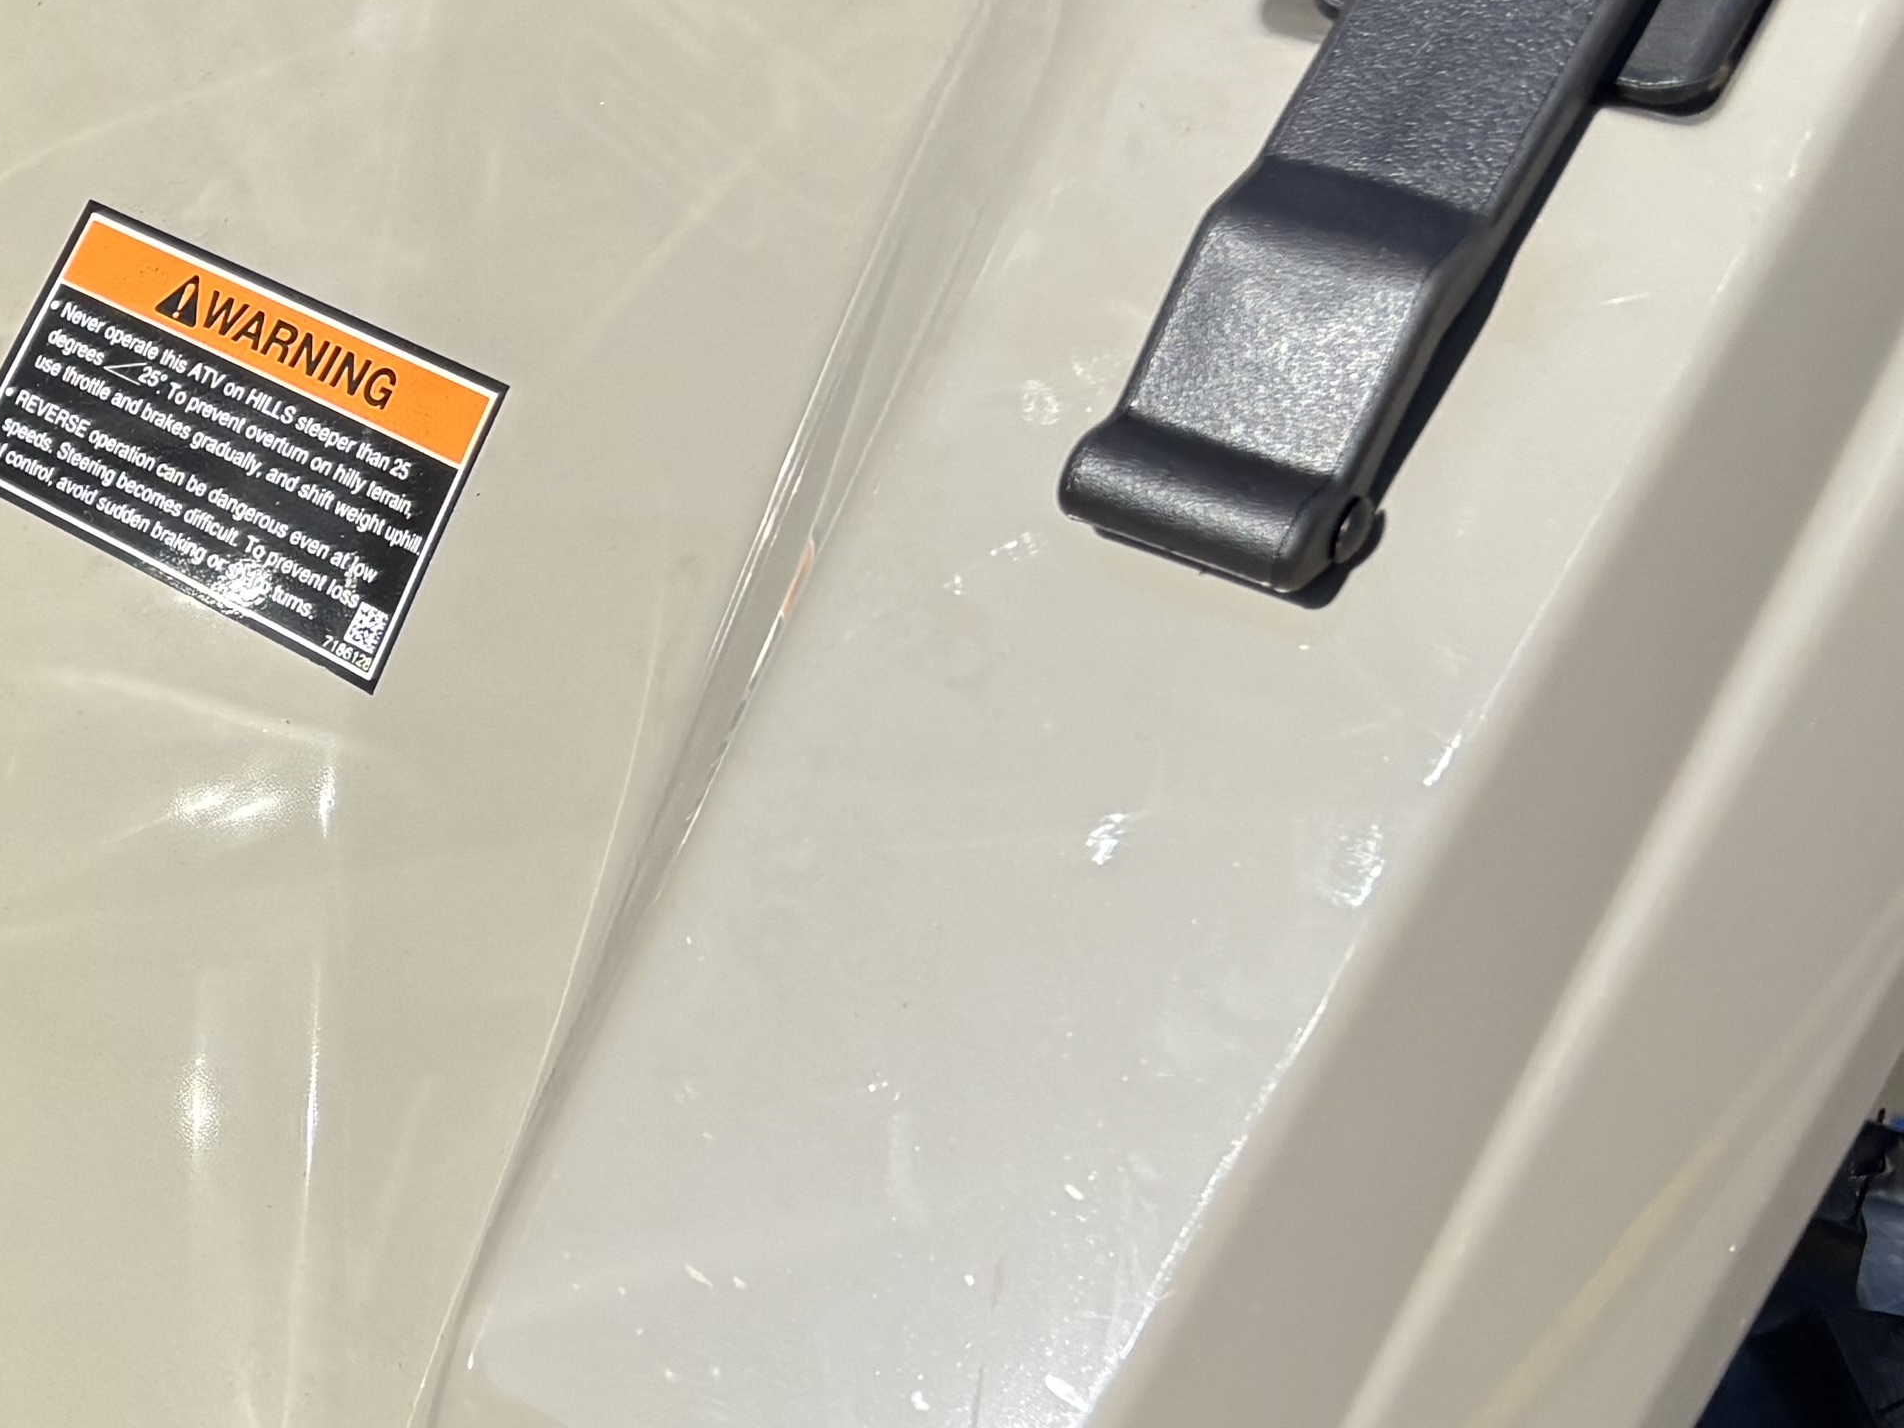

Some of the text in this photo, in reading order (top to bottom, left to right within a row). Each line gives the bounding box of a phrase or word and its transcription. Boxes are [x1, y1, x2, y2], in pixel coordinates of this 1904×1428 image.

[47, 328, 104, 365] degrees
[167, 381, 186, 404] To
[184, 396, 246, 433] prevent
[244, 424, 309, 464] overturn
[309, 456, 332, 475] on
[332, 463, 367, 493] hilly
[366, 480, 411, 519] terrain,
[60, 301, 411, 480] Never operate this ATV on HILLS steeper than 25
[204, 290, 396, 409] WARNING
[1, 417, 52, 453] speeds.
[56, 441, 116, 486] Steering
[115, 471, 182, 516] becomes
[183, 507, 239, 547] difficult.
[243, 534, 266, 565] To
[261, 551, 327, 591] prevent
[5, 450, 55, 486] control,
[55, 476, 98, 505] avoid
[95, 496, 150, 532] sudden
[149, 520, 207, 565] braking
[206, 553, 229, 578] or
[266, 580, 315, 619] turns.
[14, 389, 91, 438] REVERSE
[88, 429, 155, 471] operation
[155, 463, 185, 486] can
[185, 473, 207, 496] be
[207, 487, 289, 538] dangerous
[289, 530, 330, 559] even
[34, 354, 422, 555] use throttle and brakes gradually, and shift weight uphill.
